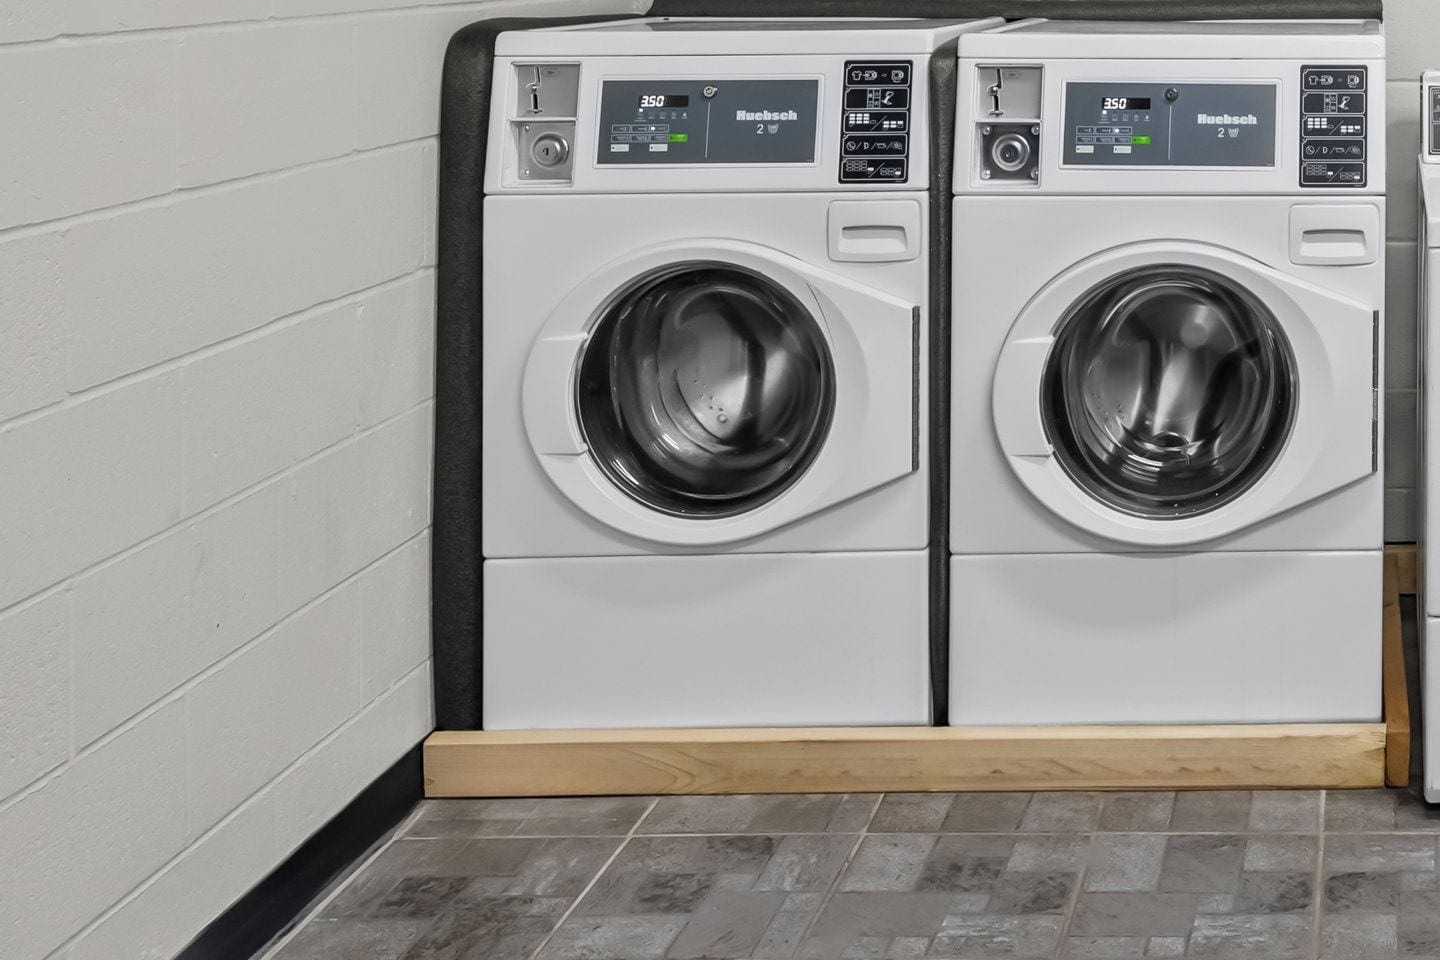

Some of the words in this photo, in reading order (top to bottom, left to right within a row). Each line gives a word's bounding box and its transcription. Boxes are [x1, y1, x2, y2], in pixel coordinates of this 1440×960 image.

[736, 110, 798, 121] Huebsch
[1197, 113, 1258, 124] Huebsch
[756, 123, 764, 134] 2
[1217, 127, 1225, 138] 2
